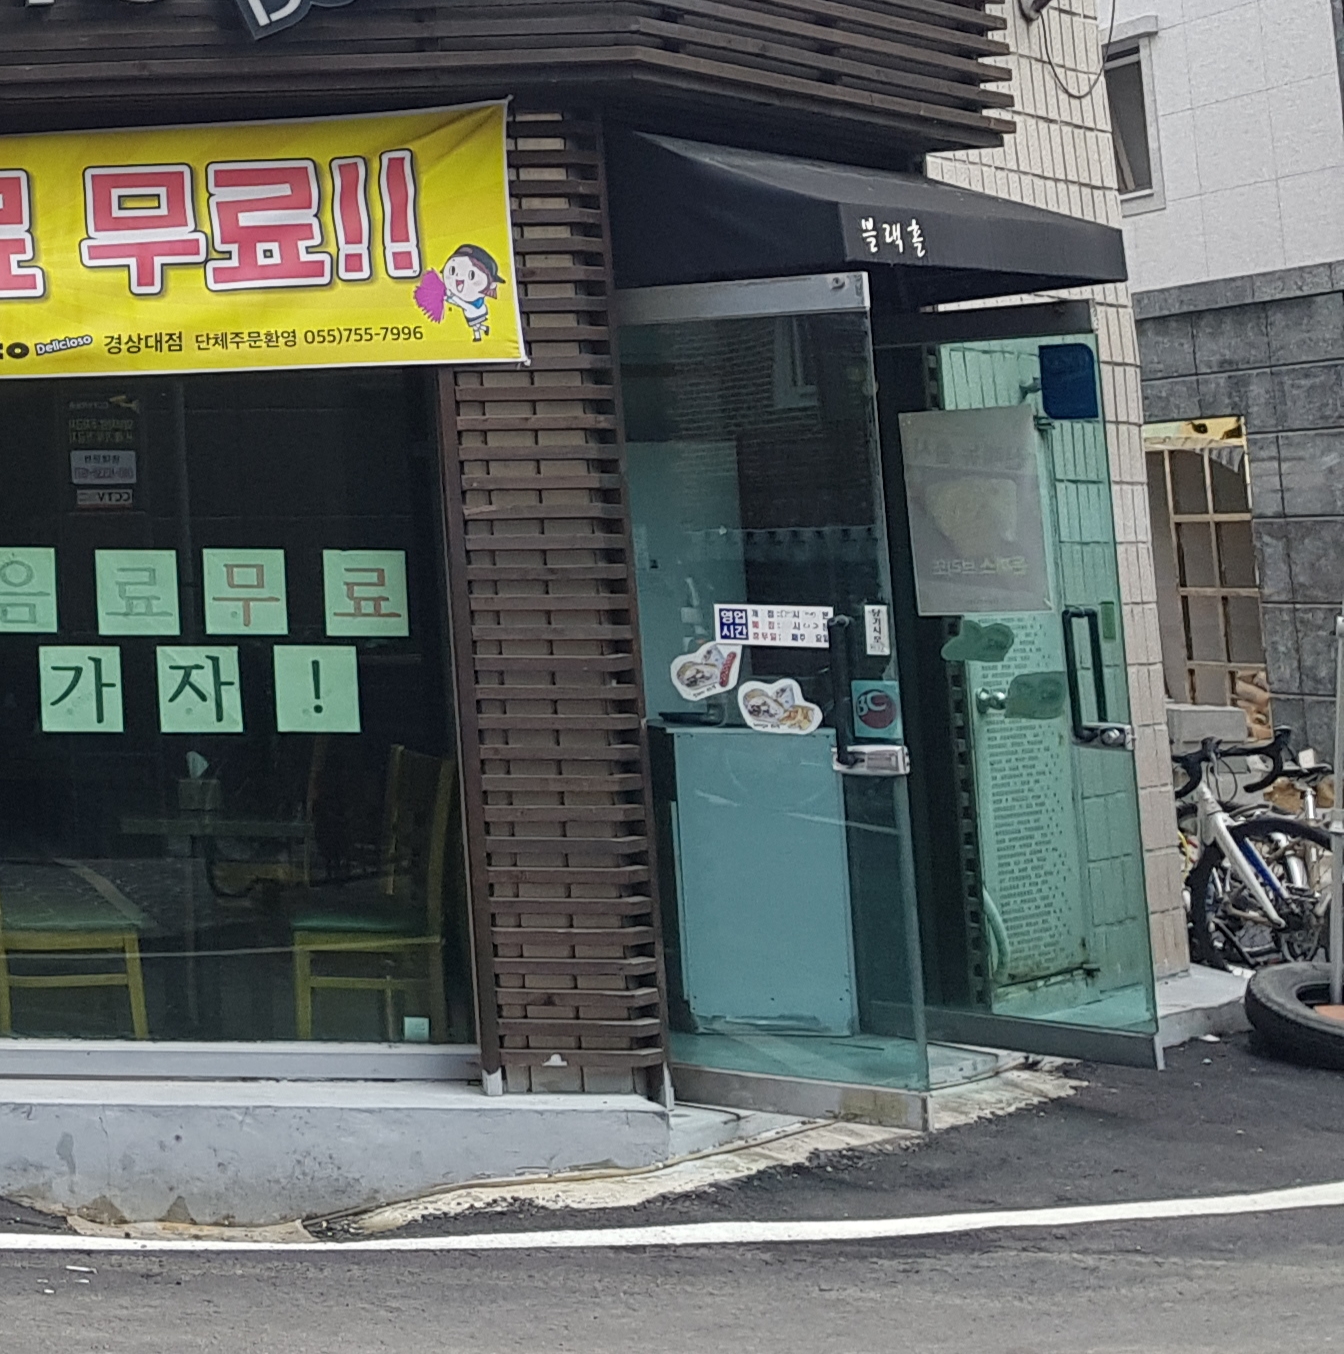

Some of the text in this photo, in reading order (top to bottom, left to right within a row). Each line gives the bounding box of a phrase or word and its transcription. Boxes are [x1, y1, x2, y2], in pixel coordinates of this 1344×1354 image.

[80, 149, 420, 296] 무료!!
[36, 334, 92, 355] Delicioso
[103, 325, 424, 354] 경상대점 단체주문환영 055)755-7996
